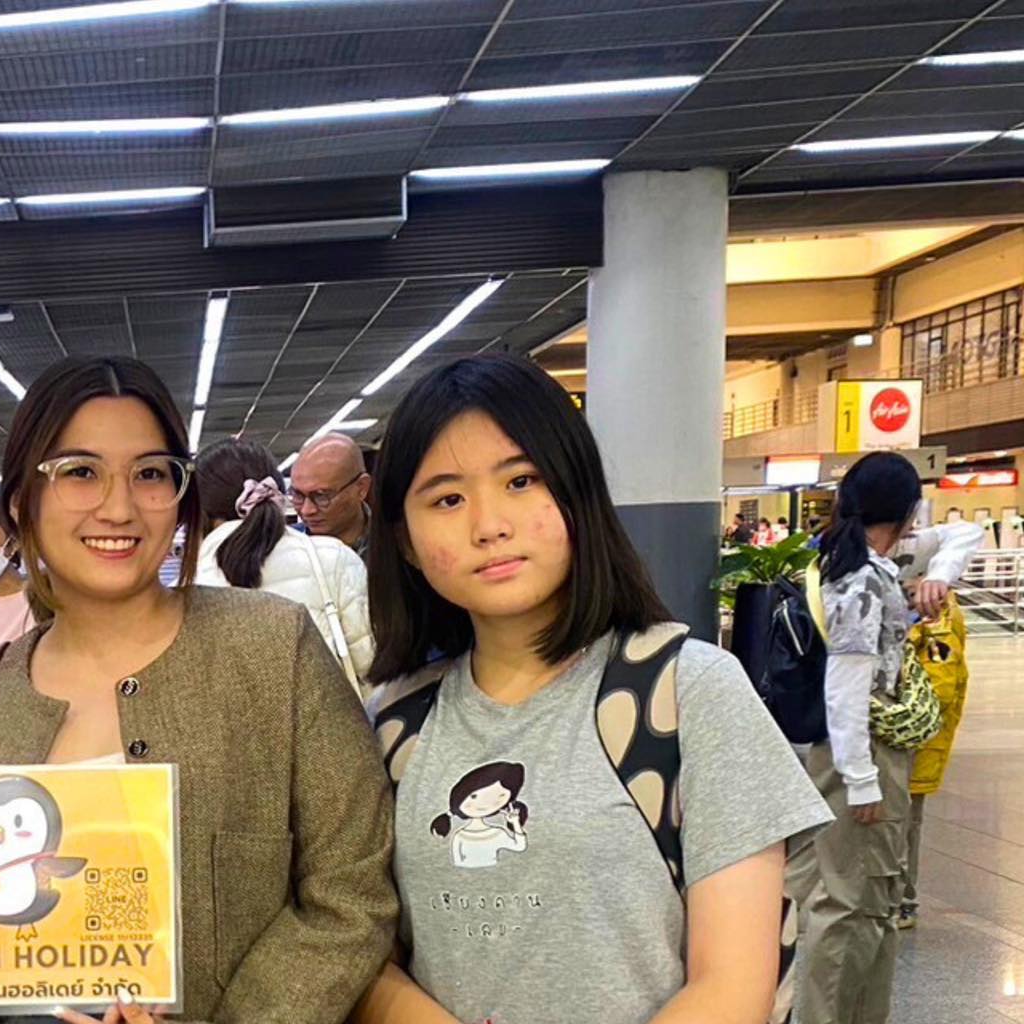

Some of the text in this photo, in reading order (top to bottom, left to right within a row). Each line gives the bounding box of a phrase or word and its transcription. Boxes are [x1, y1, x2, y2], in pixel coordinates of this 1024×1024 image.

[843, 409, 851, 433] 1
[927, 453, 935, 470] 1
[14, 943, 154, 969] HOLIDAY
